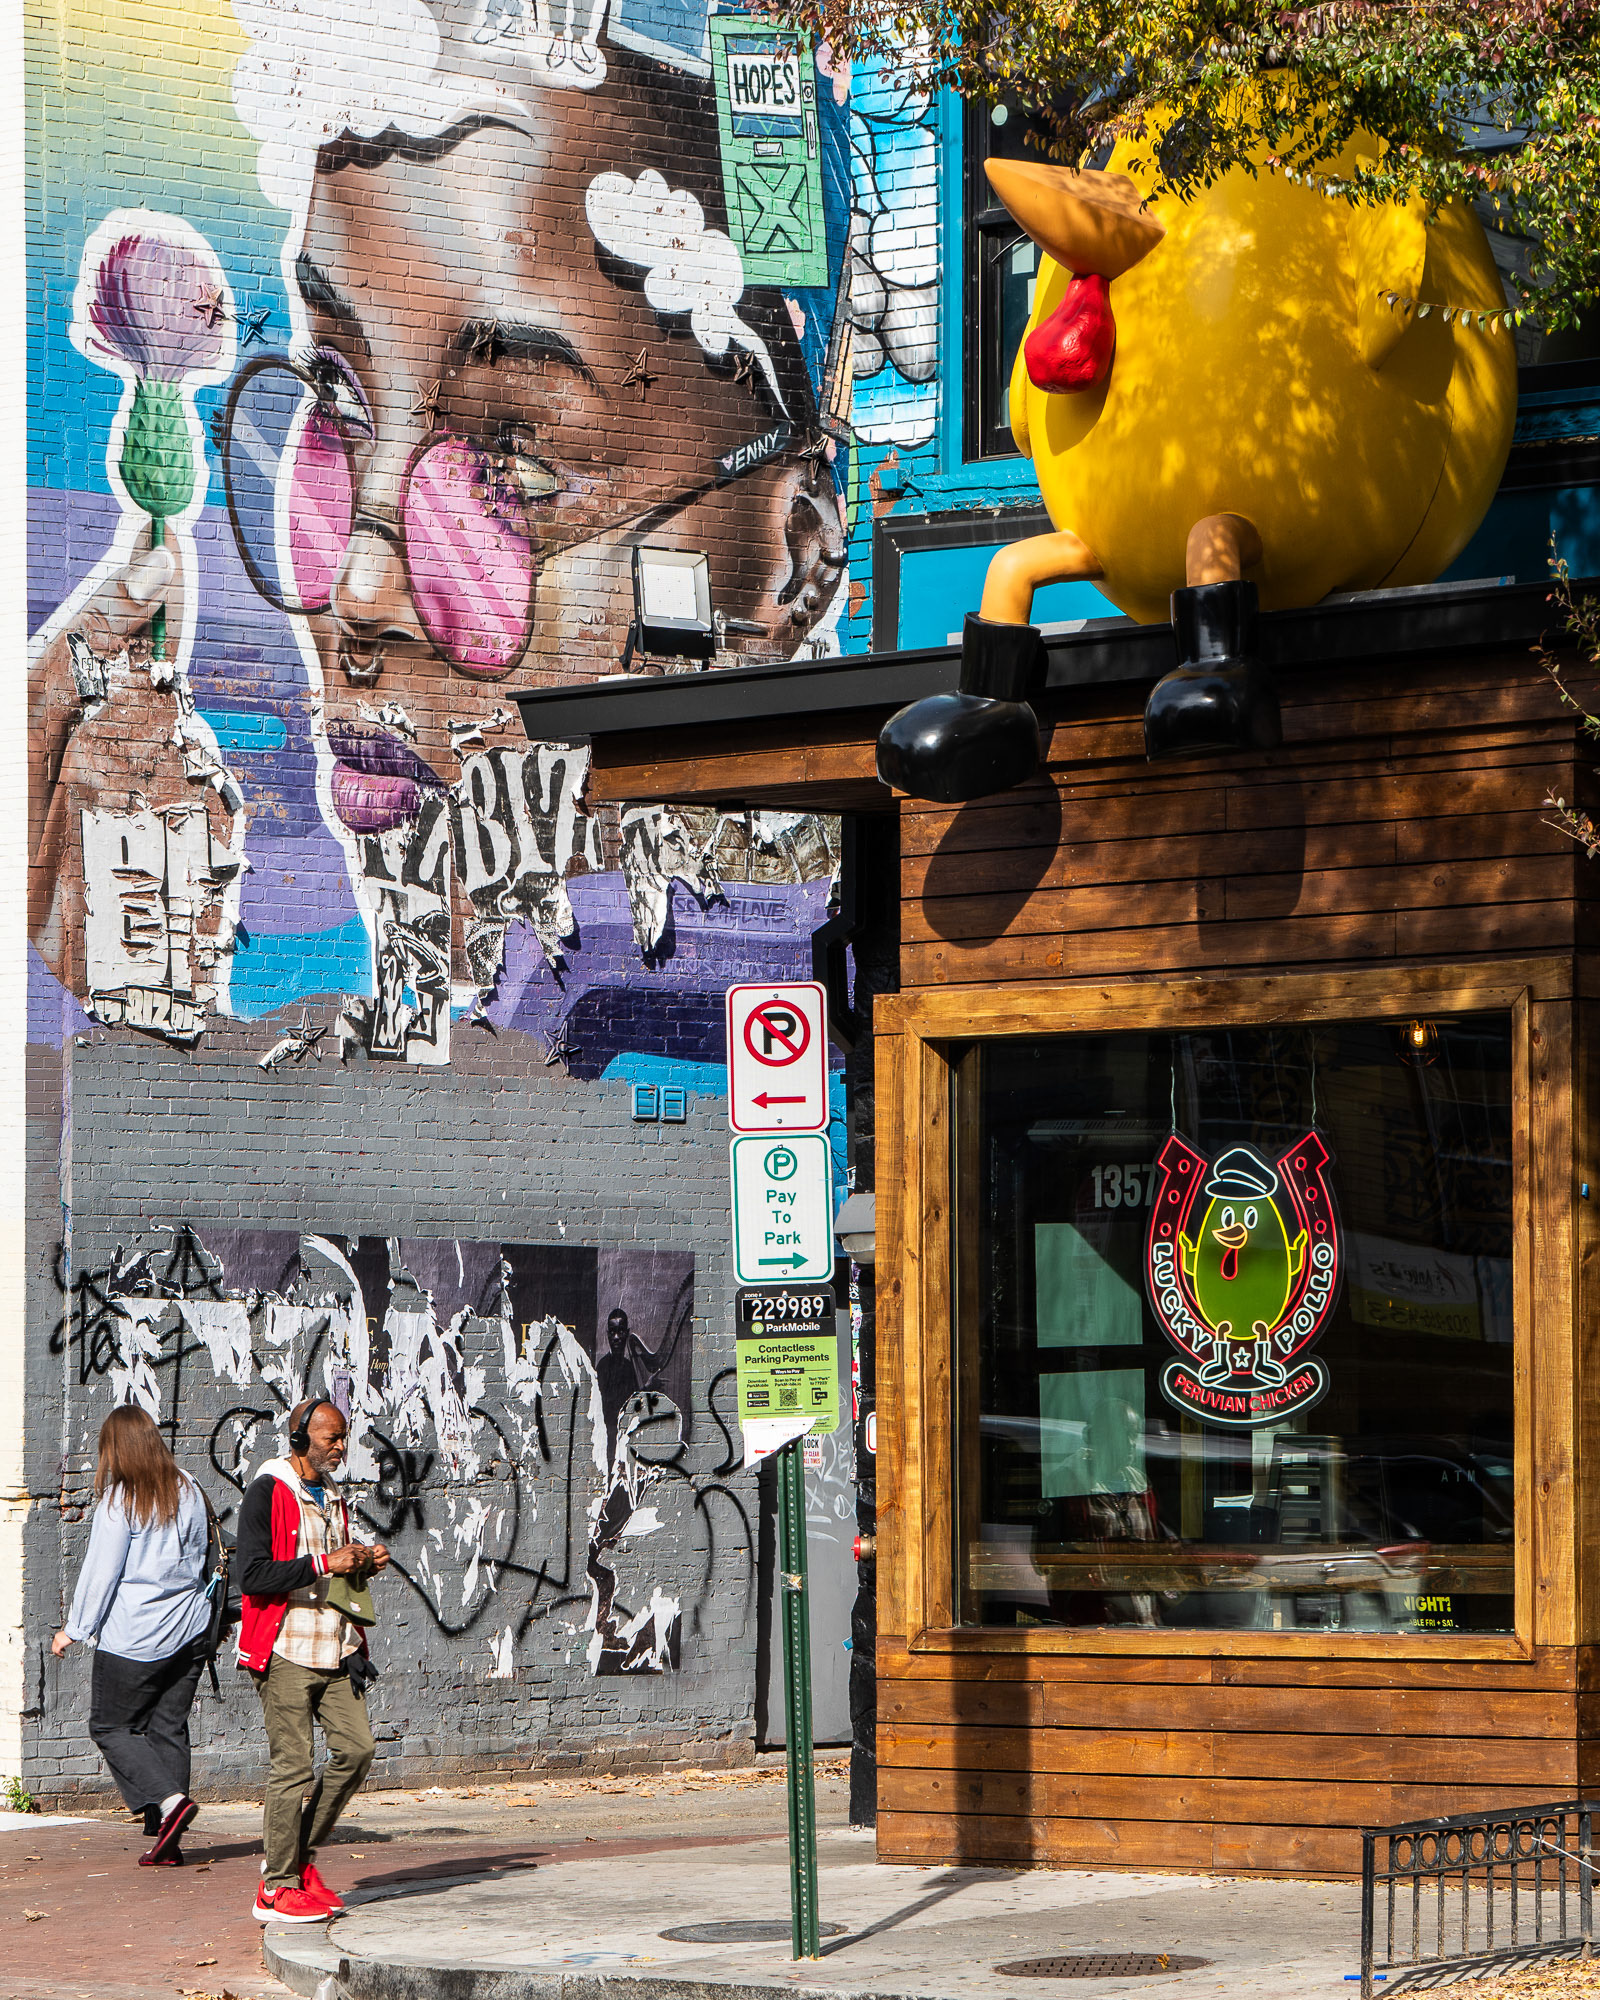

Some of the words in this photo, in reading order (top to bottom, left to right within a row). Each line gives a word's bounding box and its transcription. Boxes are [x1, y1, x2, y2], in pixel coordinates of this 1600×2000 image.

[733, 63, 796, 105] HOPES
[1091, 1164, 1155, 1208] 1357
[766, 1189, 797, 1205] Pay
[771, 1210, 792, 1224] To
[764, 1231, 801, 1246] Park
[1152, 1241, 1213, 1354] LUCKY
[1274, 1241, 1335, 1355] POLLO
[751, 1296, 824, 1321] 229989
[765, 1321, 821, 1333] ParkMobile
[758, 1343, 816, 1354] Contactless
[744, 1354, 781, 1365] Parking
[782, 1353, 830, 1364] Payments
[1173, 1372, 1247, 1414] PERUVIAN
[1248, 1371, 1315, 1413] CHICKEN
[803, 1438, 820, 1449] LOCK
[1440, 1469, 1476, 1483] ATM
[1425, 1619, 1435, 1627] FRI
